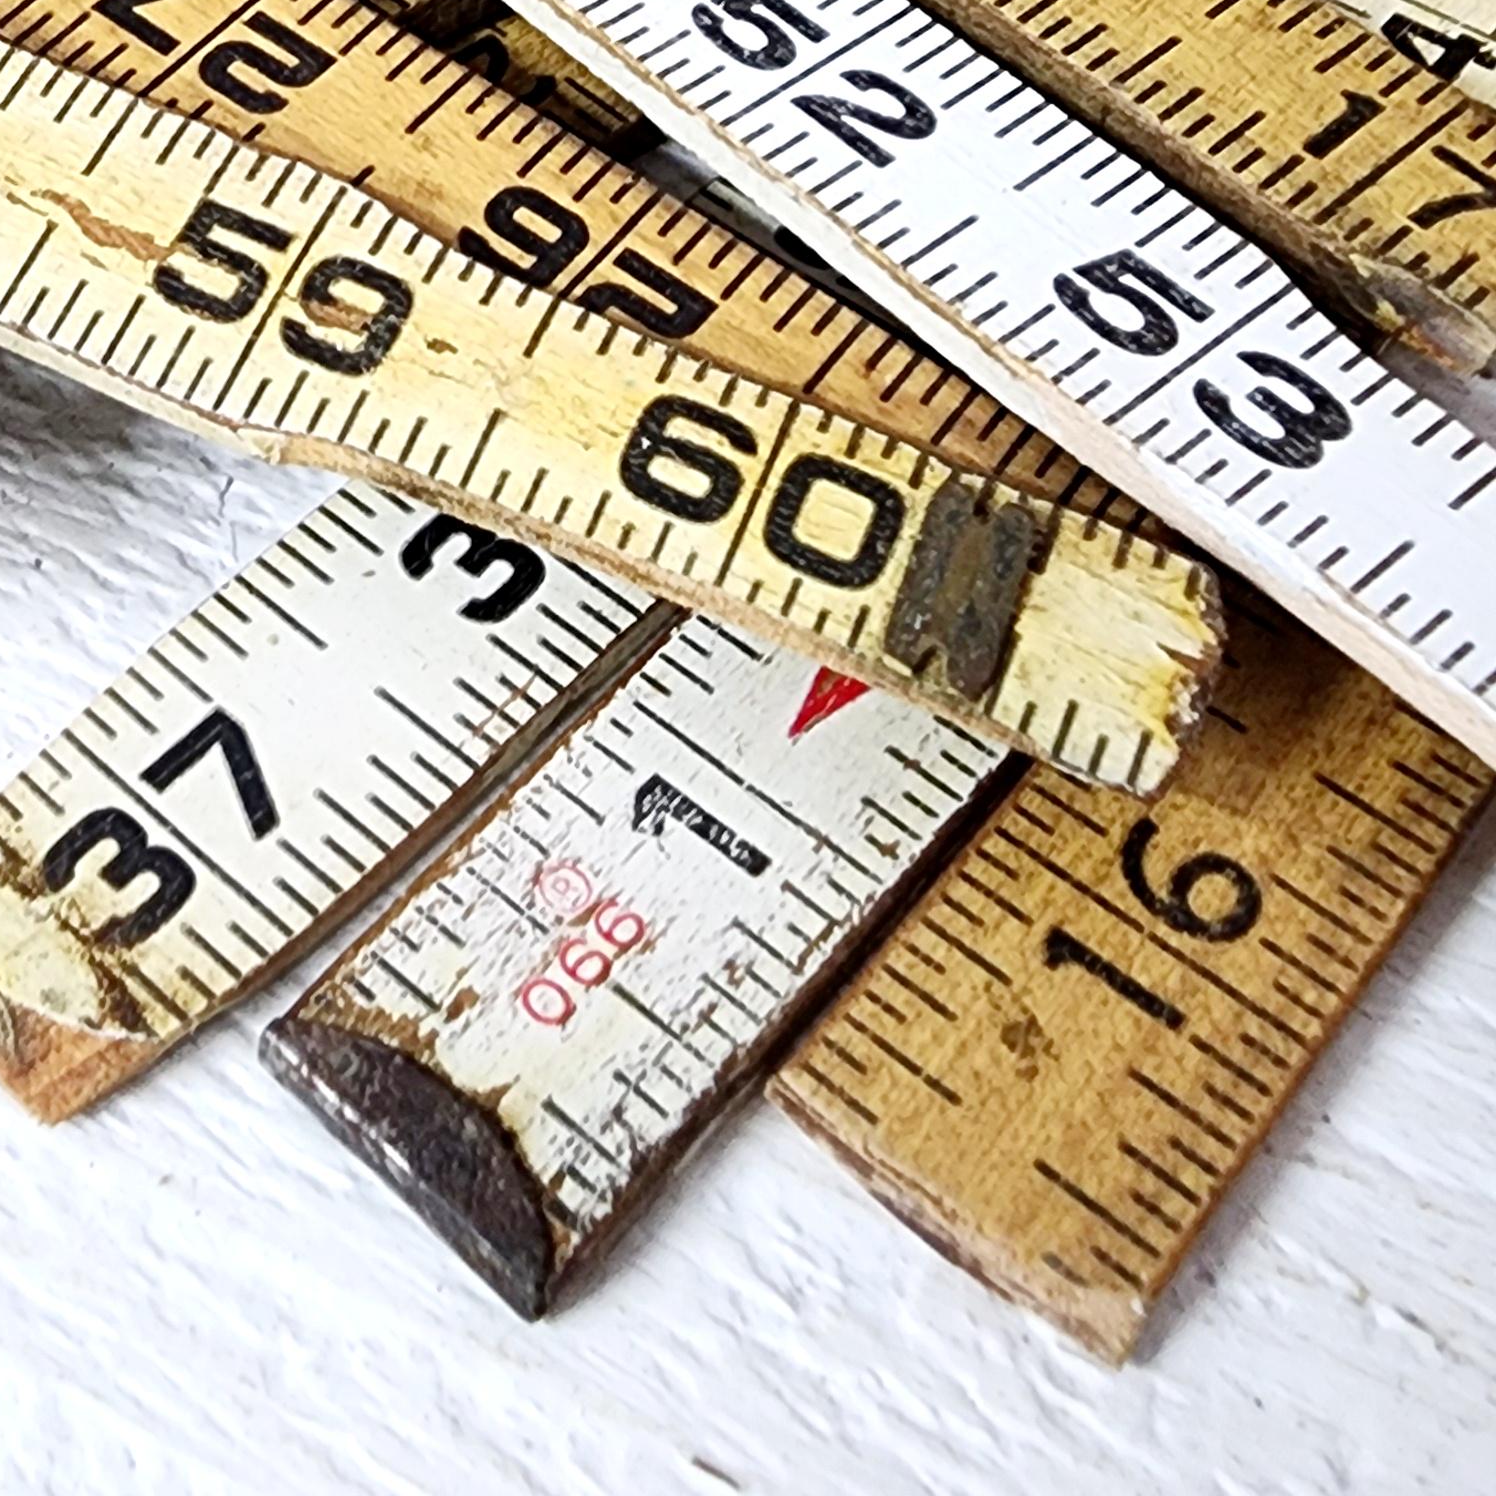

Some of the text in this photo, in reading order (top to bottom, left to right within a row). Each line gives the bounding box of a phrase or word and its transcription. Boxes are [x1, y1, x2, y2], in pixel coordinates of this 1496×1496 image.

[458, 185, 720, 339] 26
[1302, 89, 1496, 231] 17
[150, 198, 415, 378] 59
[617, 394, 904, 590] 60
[1053, 249, 1354, 469] 53
[42, 510, 549, 951] 37 3
[1042, 816, 1262, 1029] 16
